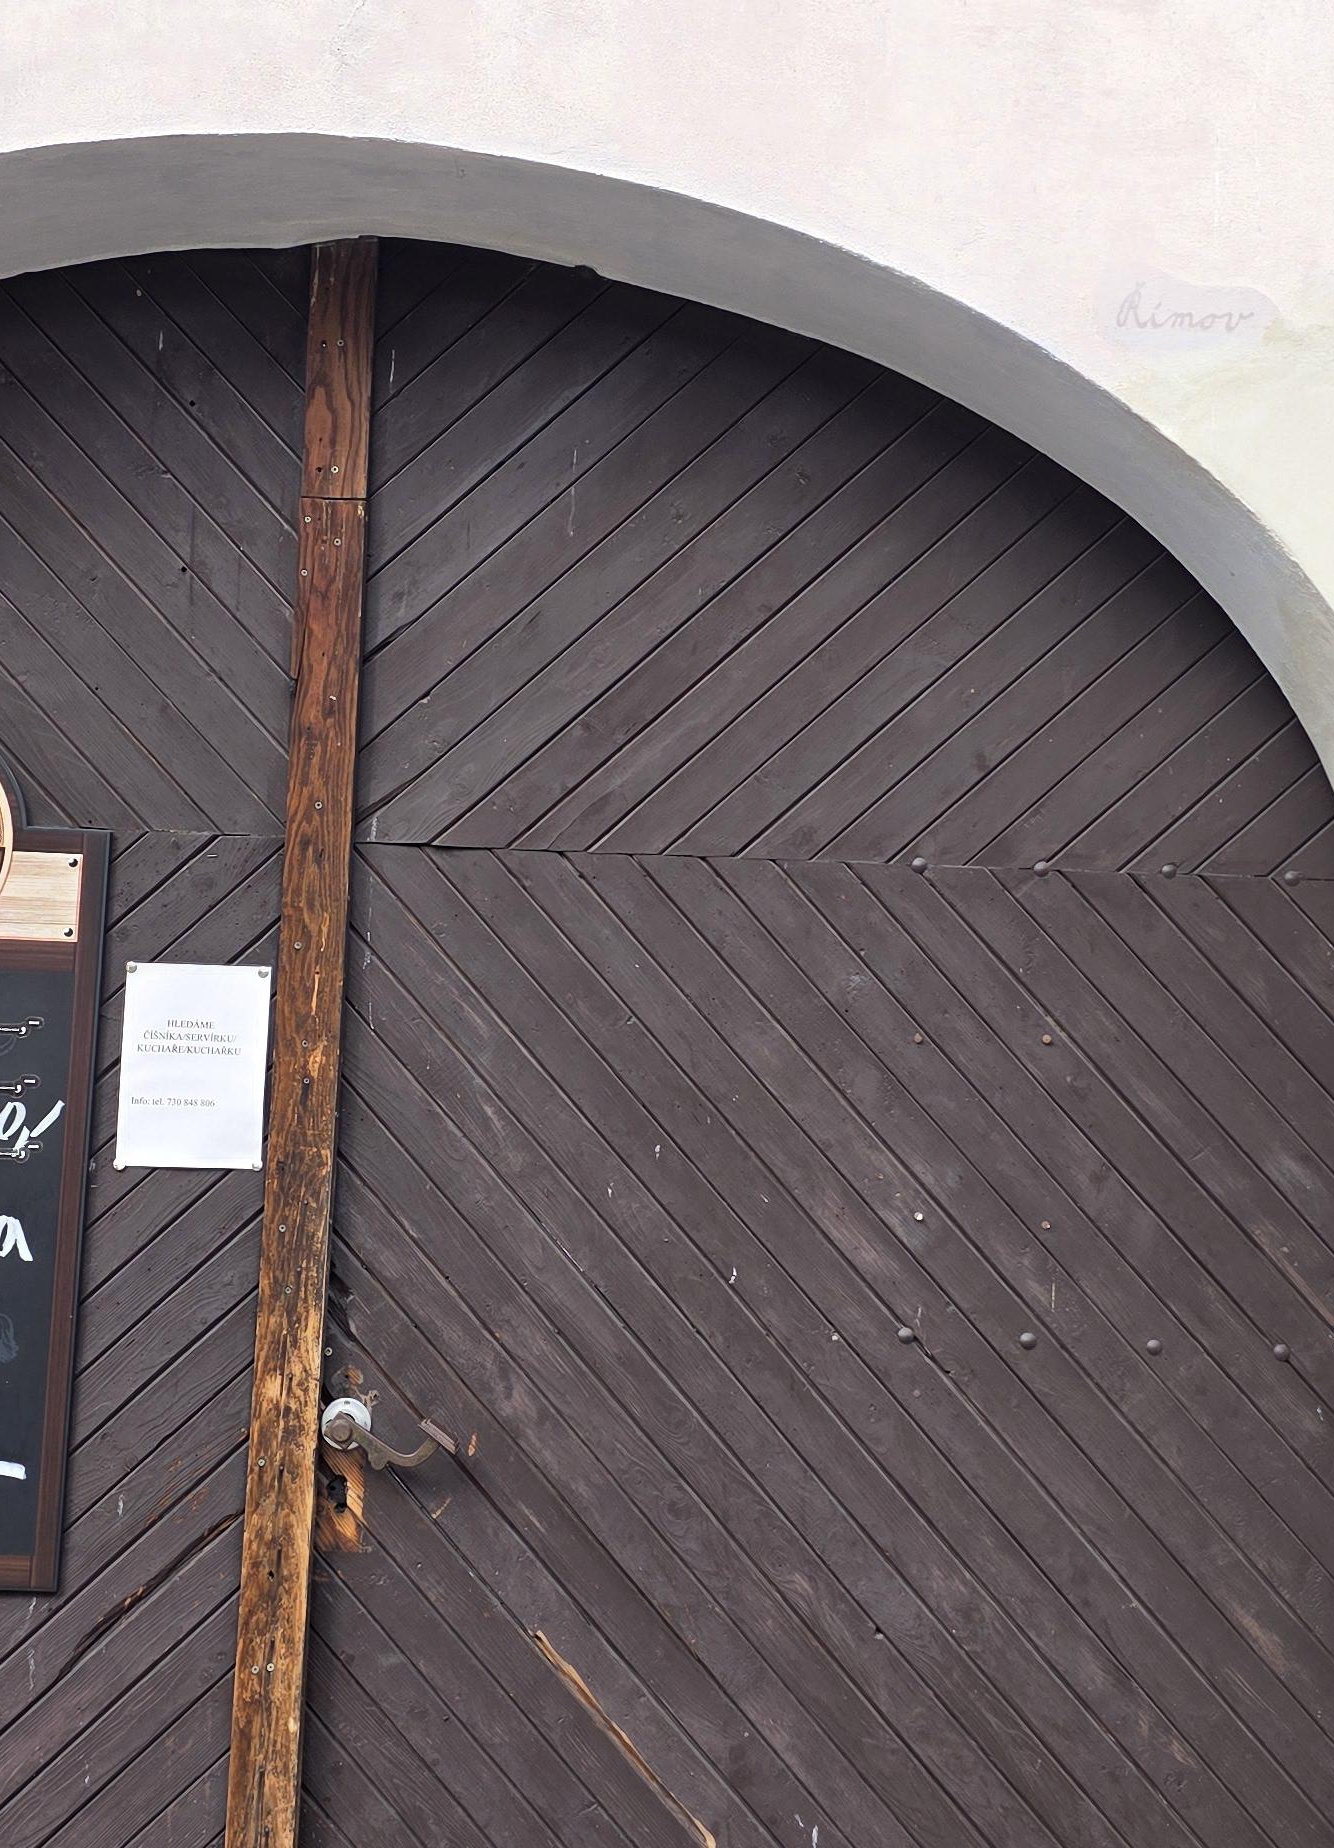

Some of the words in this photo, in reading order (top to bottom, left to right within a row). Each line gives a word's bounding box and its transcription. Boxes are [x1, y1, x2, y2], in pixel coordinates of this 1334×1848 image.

[167, 1018, 215, 1029] HLEDÁME
[131, 1096, 150, 1105] Info:
[166, 1097, 182, 1106] 730
